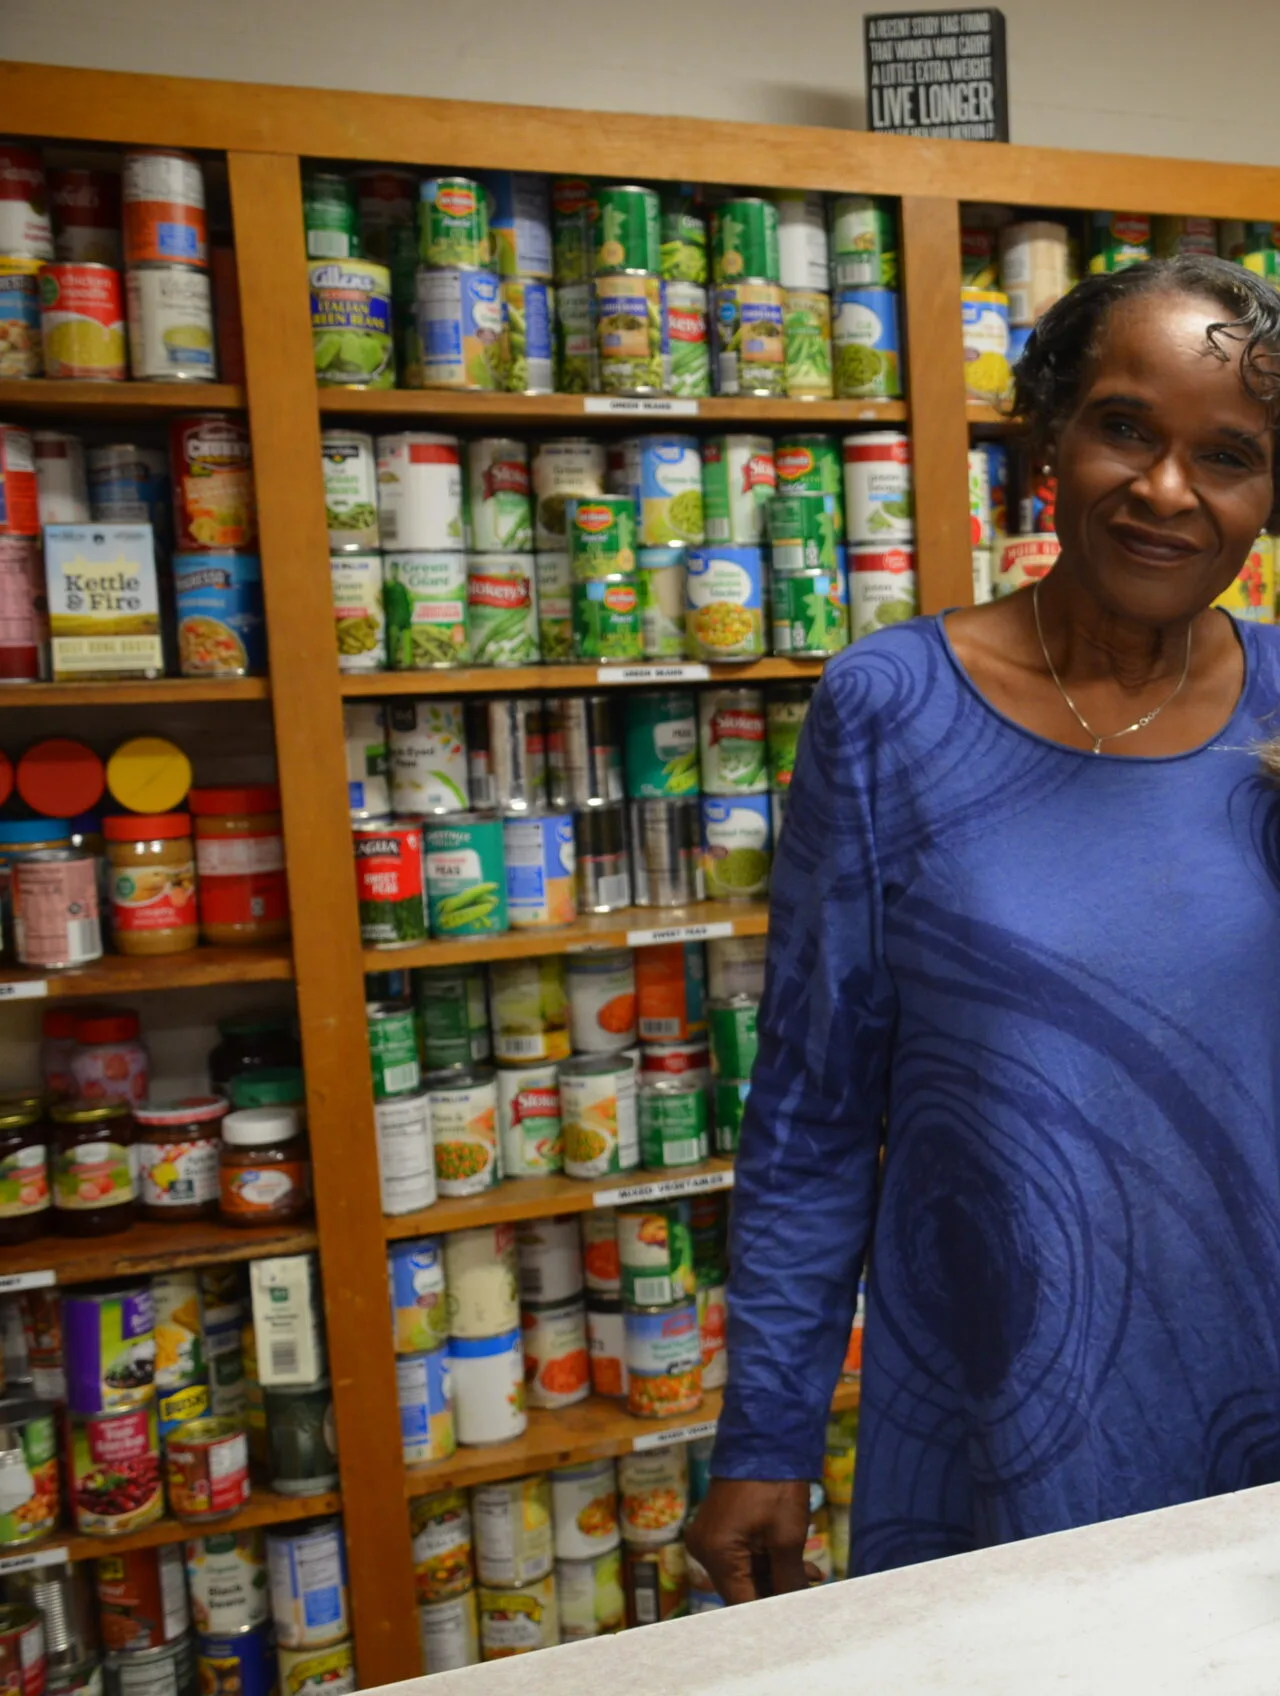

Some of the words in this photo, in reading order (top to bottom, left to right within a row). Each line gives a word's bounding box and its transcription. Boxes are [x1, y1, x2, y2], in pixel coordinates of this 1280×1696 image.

[869, 20, 877, 38] A
[877, 18, 911, 37] RECENT
[912, 16, 940, 36] STUDY
[940, 14, 960, 35] HAS
[960, 12, 991, 34] FOUND
[870, 41, 893, 61] THAT
[894, 39, 934, 60] WOMEN
[933, 37, 958, 58] WHO
[958, 35, 991, 57] CARRY
[872, 63, 880, 86] A
[880, 61, 915, 84] LITTLE
[915, 60, 951, 83] EXTRA
[950, 56, 993, 81] WEIGHT
[872, 86, 916, 127] LIVE
[918, 81, 995, 125] LONGER
[63, 572, 140, 593] Kettle
[66, 595, 84, 611] &
[90, 594, 142, 611] Fire
[619, 1187, 653, 1198] MIXED
[657, 1175, 724, 1193] VEGETABLES
